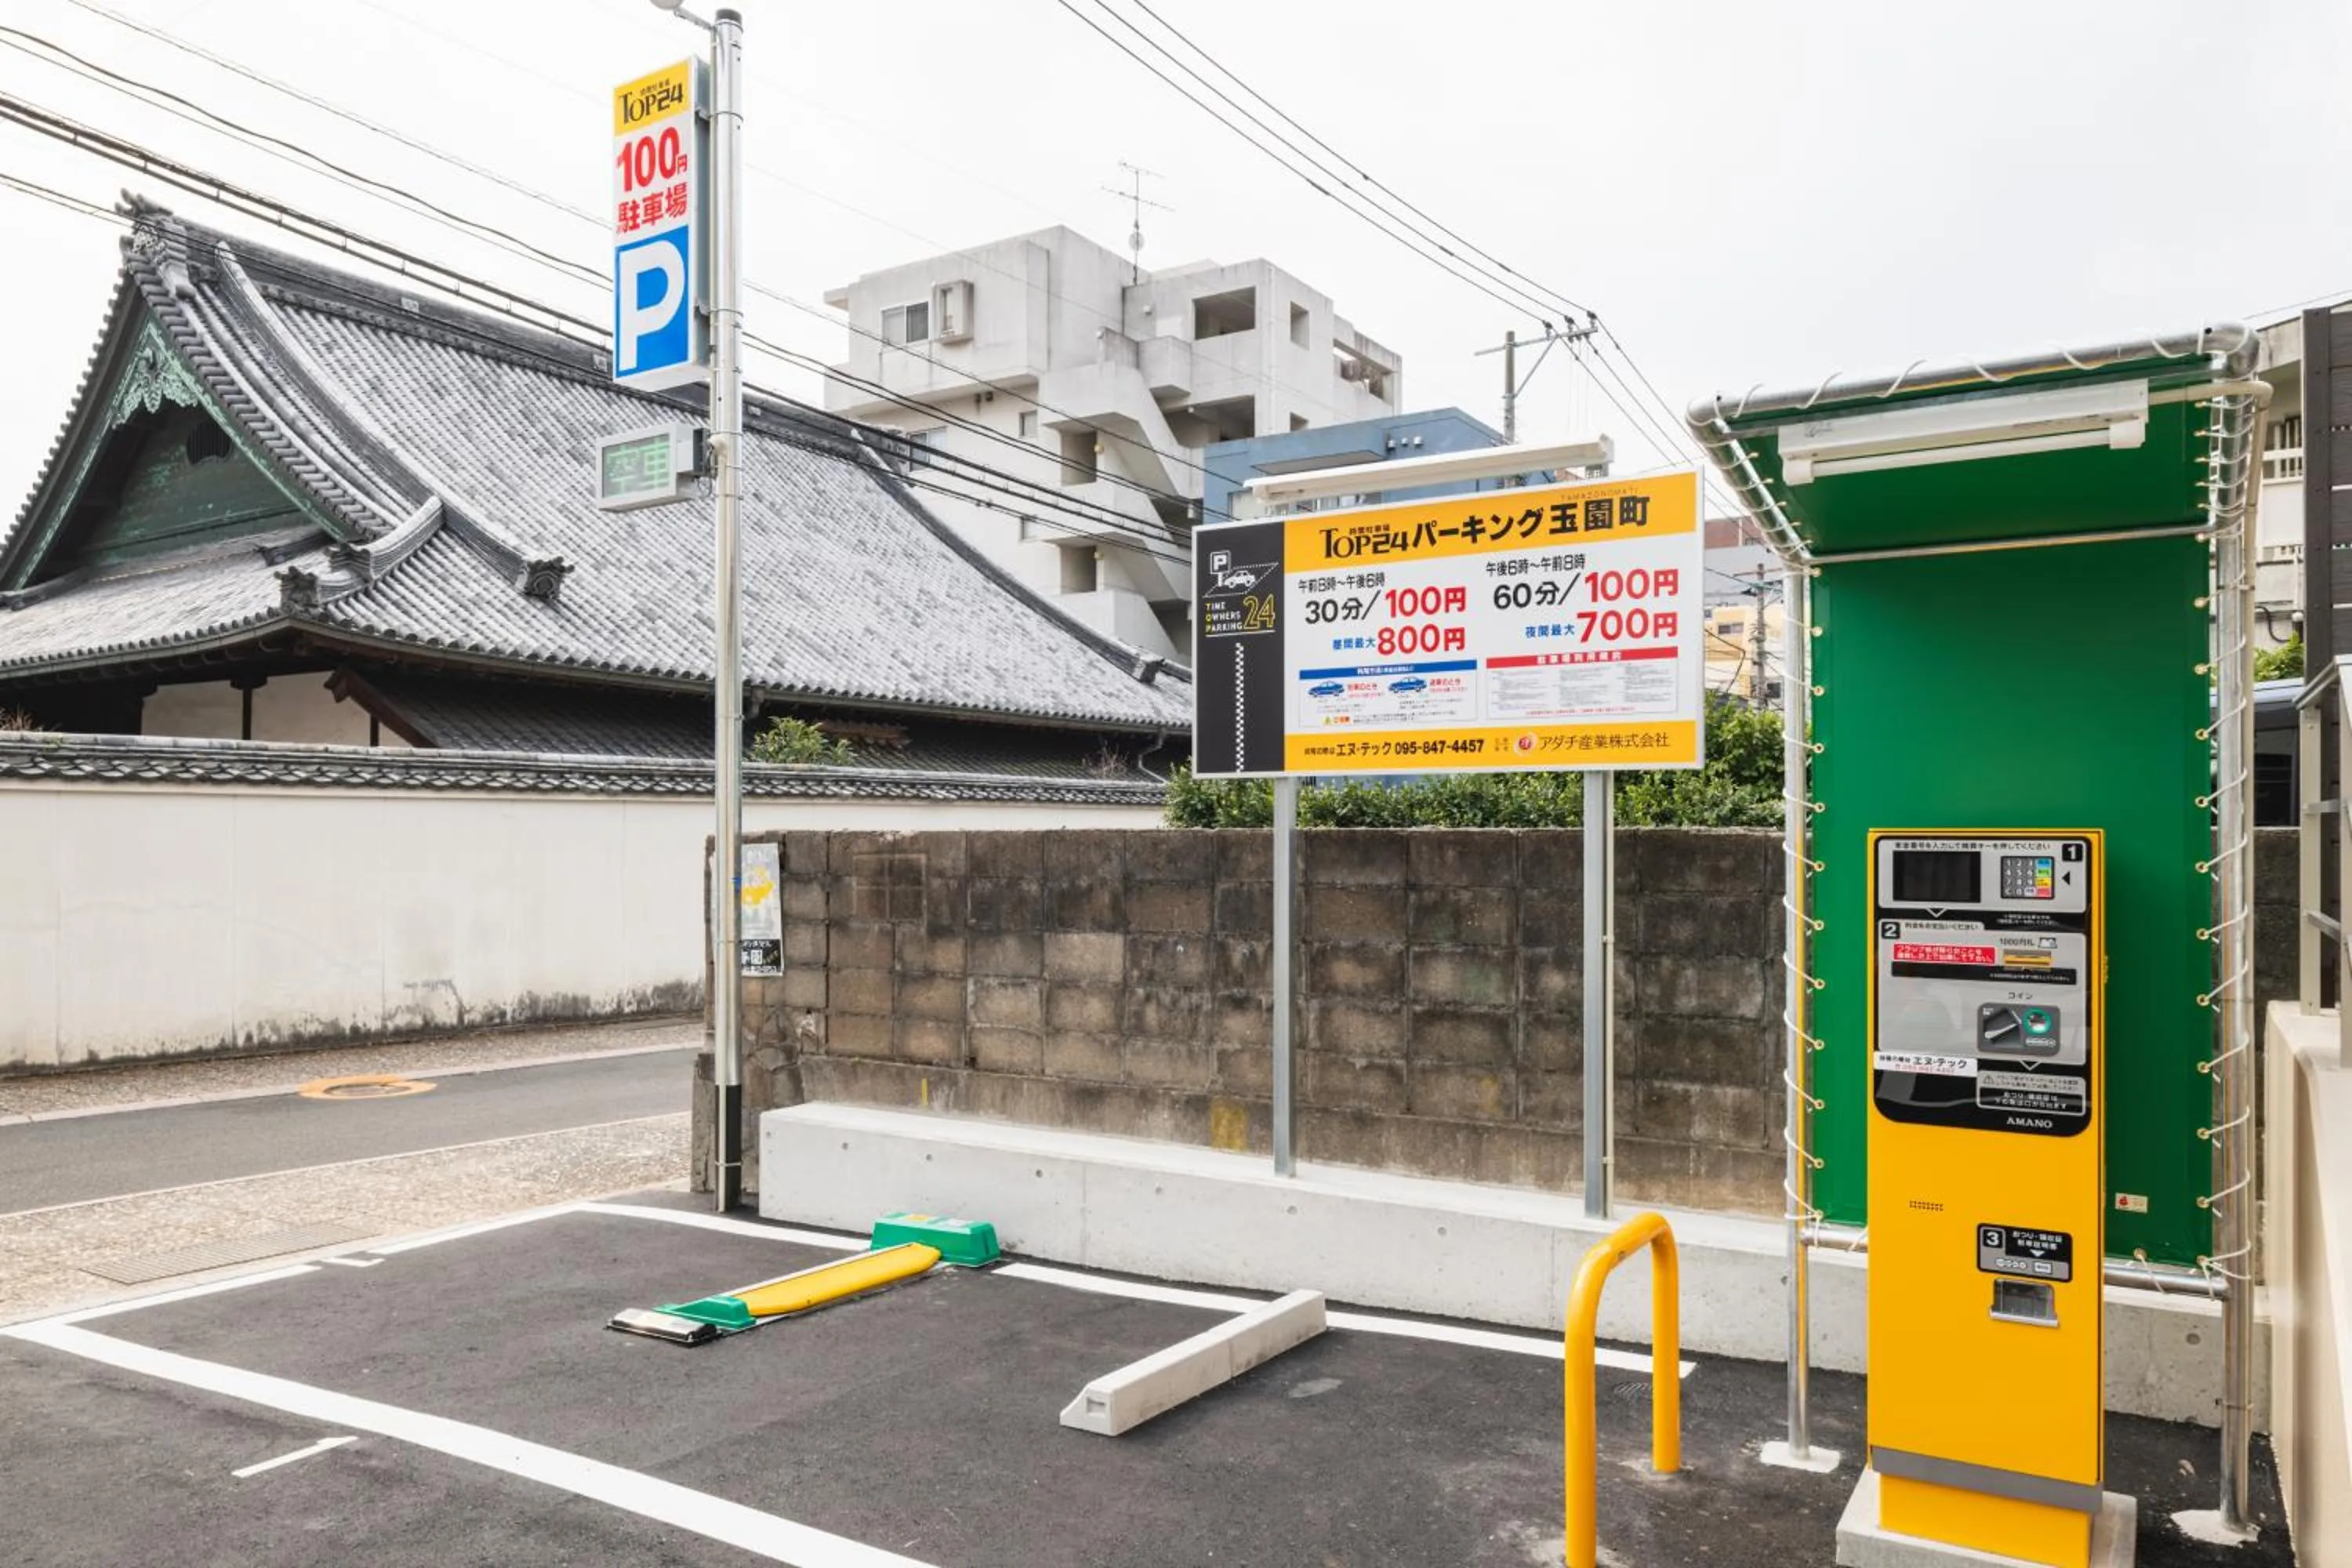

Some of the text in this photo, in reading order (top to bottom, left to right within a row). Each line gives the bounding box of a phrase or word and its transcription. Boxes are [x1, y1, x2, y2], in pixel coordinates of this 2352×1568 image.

[617, 126, 688, 193] 100円
[617, 182, 688, 234] 駐車場
[618, 240, 685, 372] P
[1319, 528, 1409, 558] TOP24
[1243, 593, 1276, 630] 24
[1395, 739, 1485, 755] 095-847-4457
[2067, 846, 2077, 860] 1
[1884, 923, 1897, 938] 2
[2006, 1116, 2053, 1129] AMANO
[1986, 1232, 1999, 1246] 3
